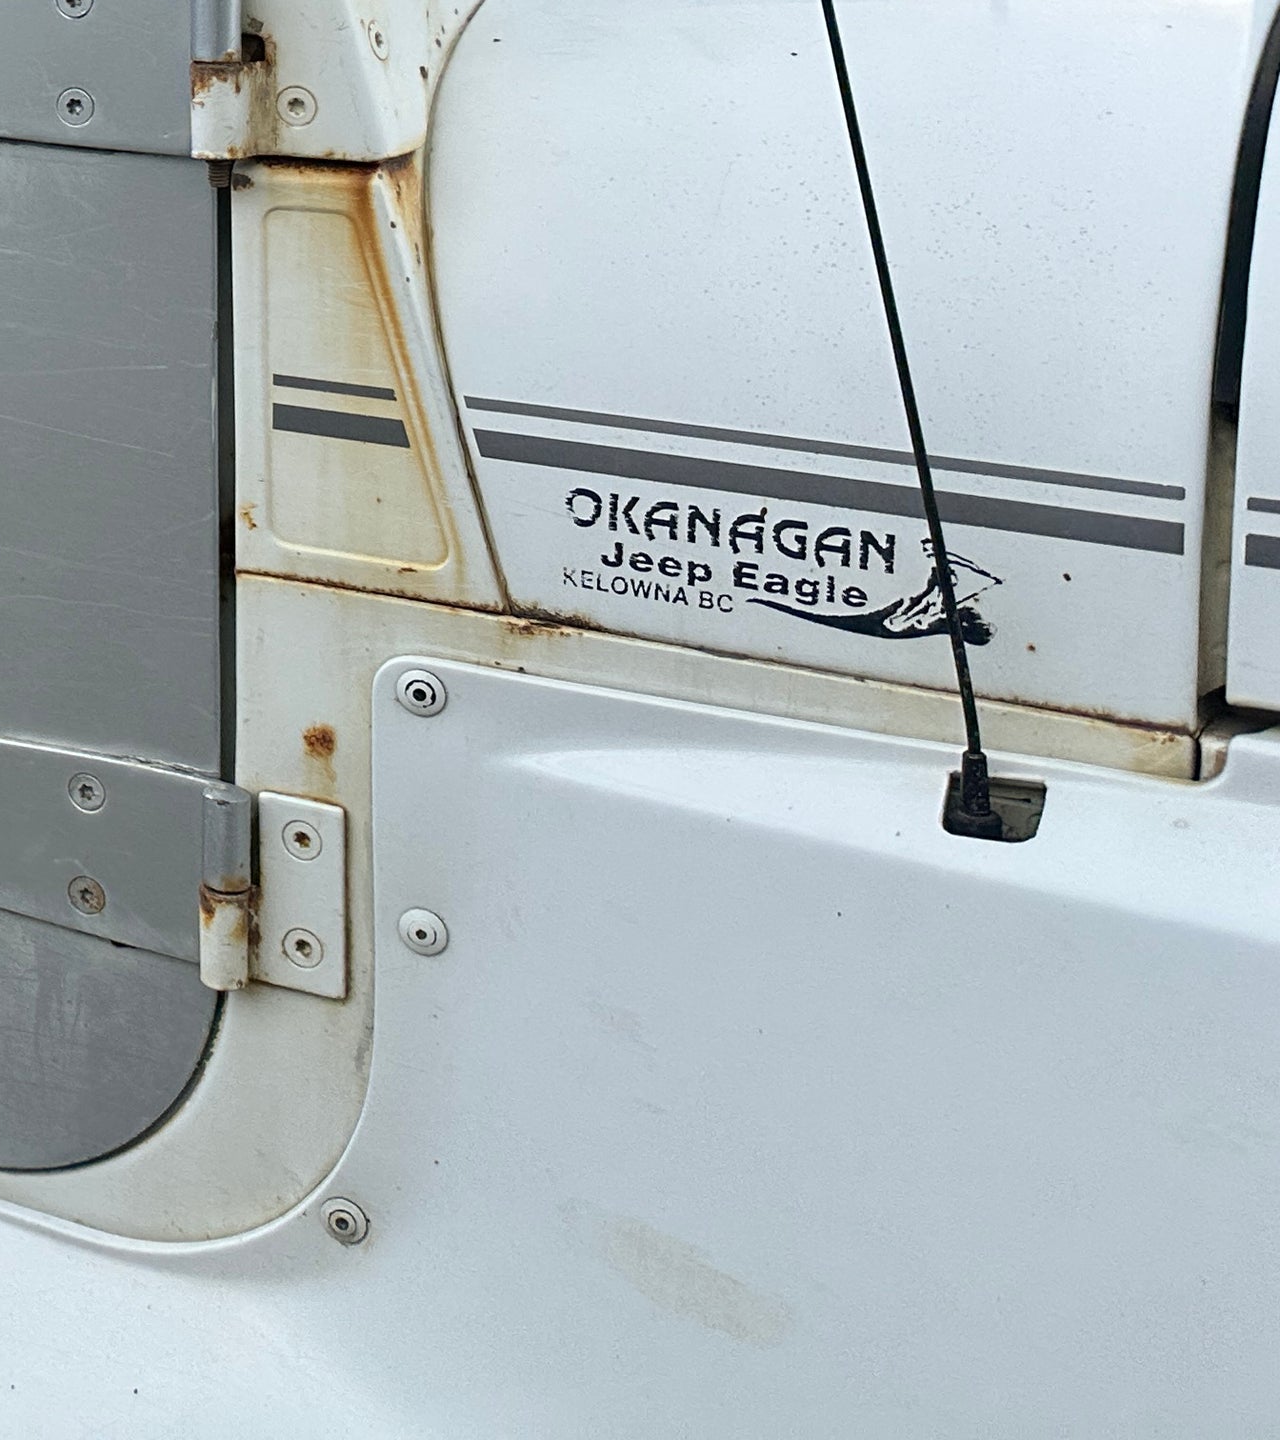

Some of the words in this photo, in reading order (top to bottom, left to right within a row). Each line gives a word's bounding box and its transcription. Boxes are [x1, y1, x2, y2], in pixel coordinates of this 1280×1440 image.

[565, 487, 896, 574] OKANAGAN
[562, 567, 689, 606] KELOWNA
[698, 591, 735, 613] BC
[600, 541, 713, 586] Jeep
[733, 560, 868, 607] Eagle
